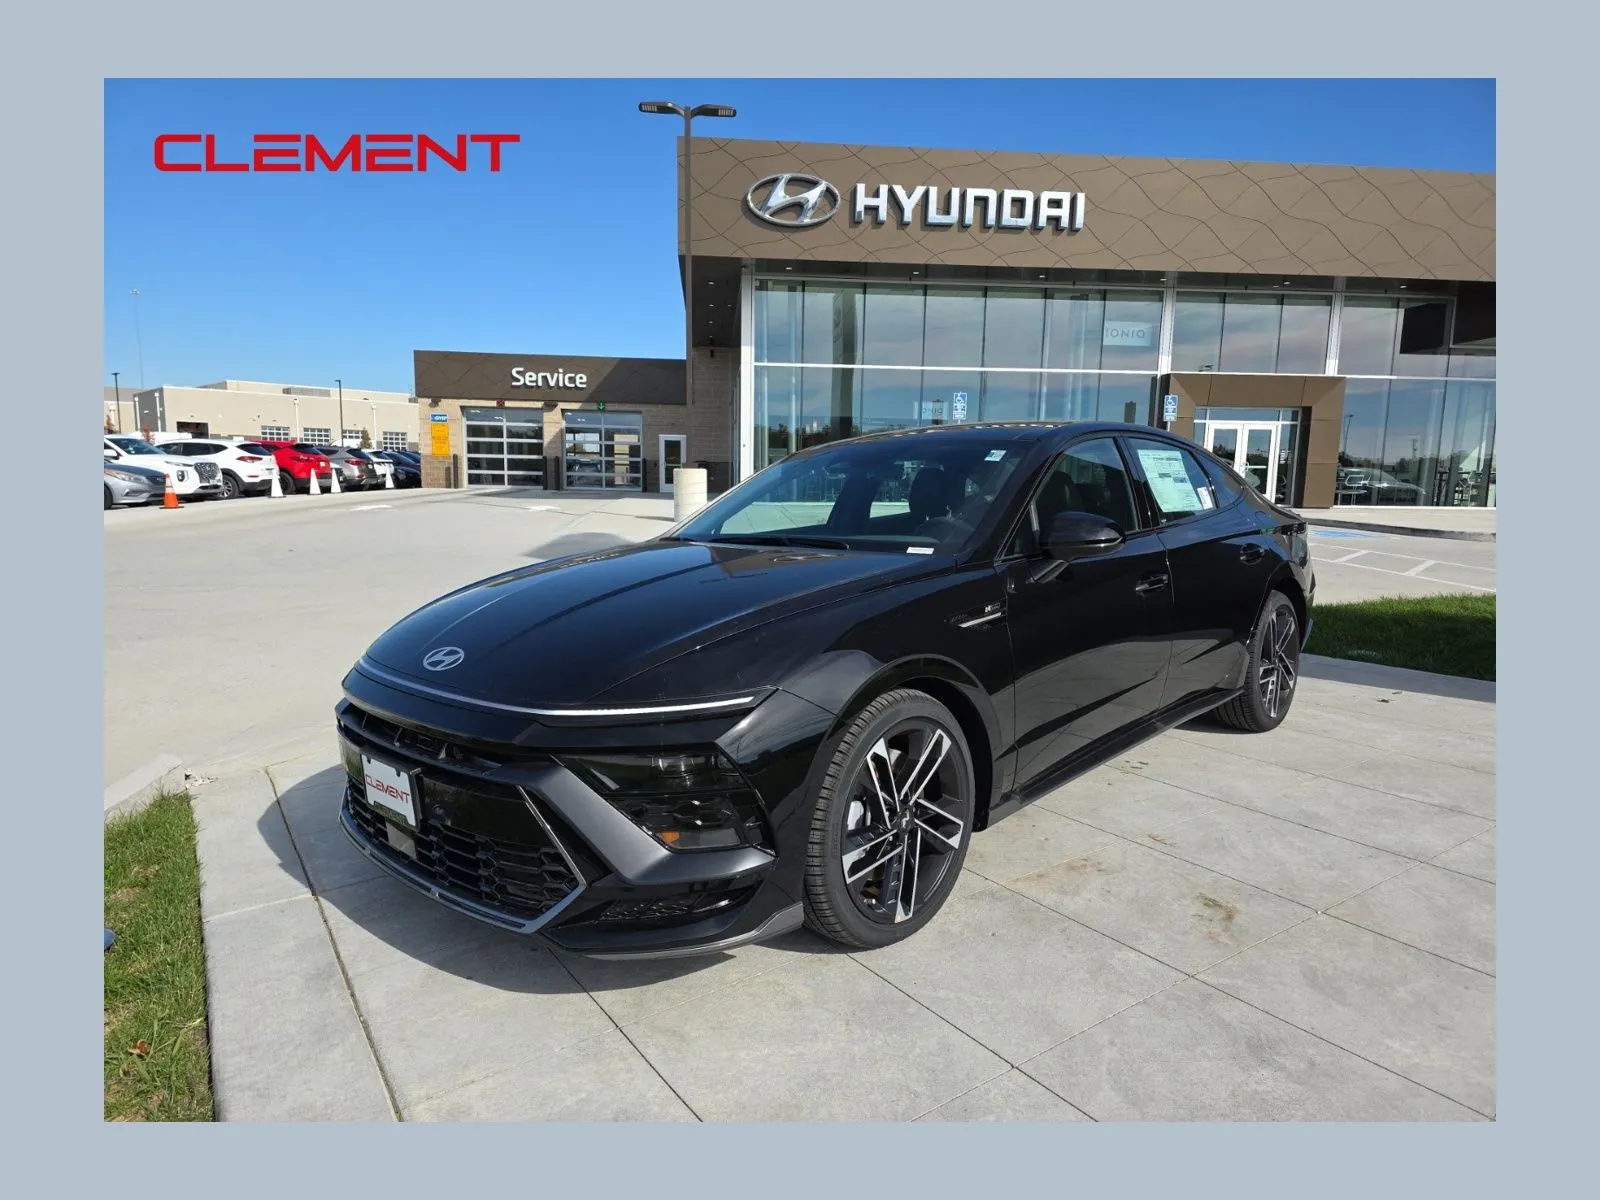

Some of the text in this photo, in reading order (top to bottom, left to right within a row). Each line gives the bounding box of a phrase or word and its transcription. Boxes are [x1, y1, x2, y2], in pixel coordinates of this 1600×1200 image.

[855, 183, 1086, 231] HYUNDAI
[511, 367, 587, 388] Service
[365, 774, 410, 804] CLEMENT
